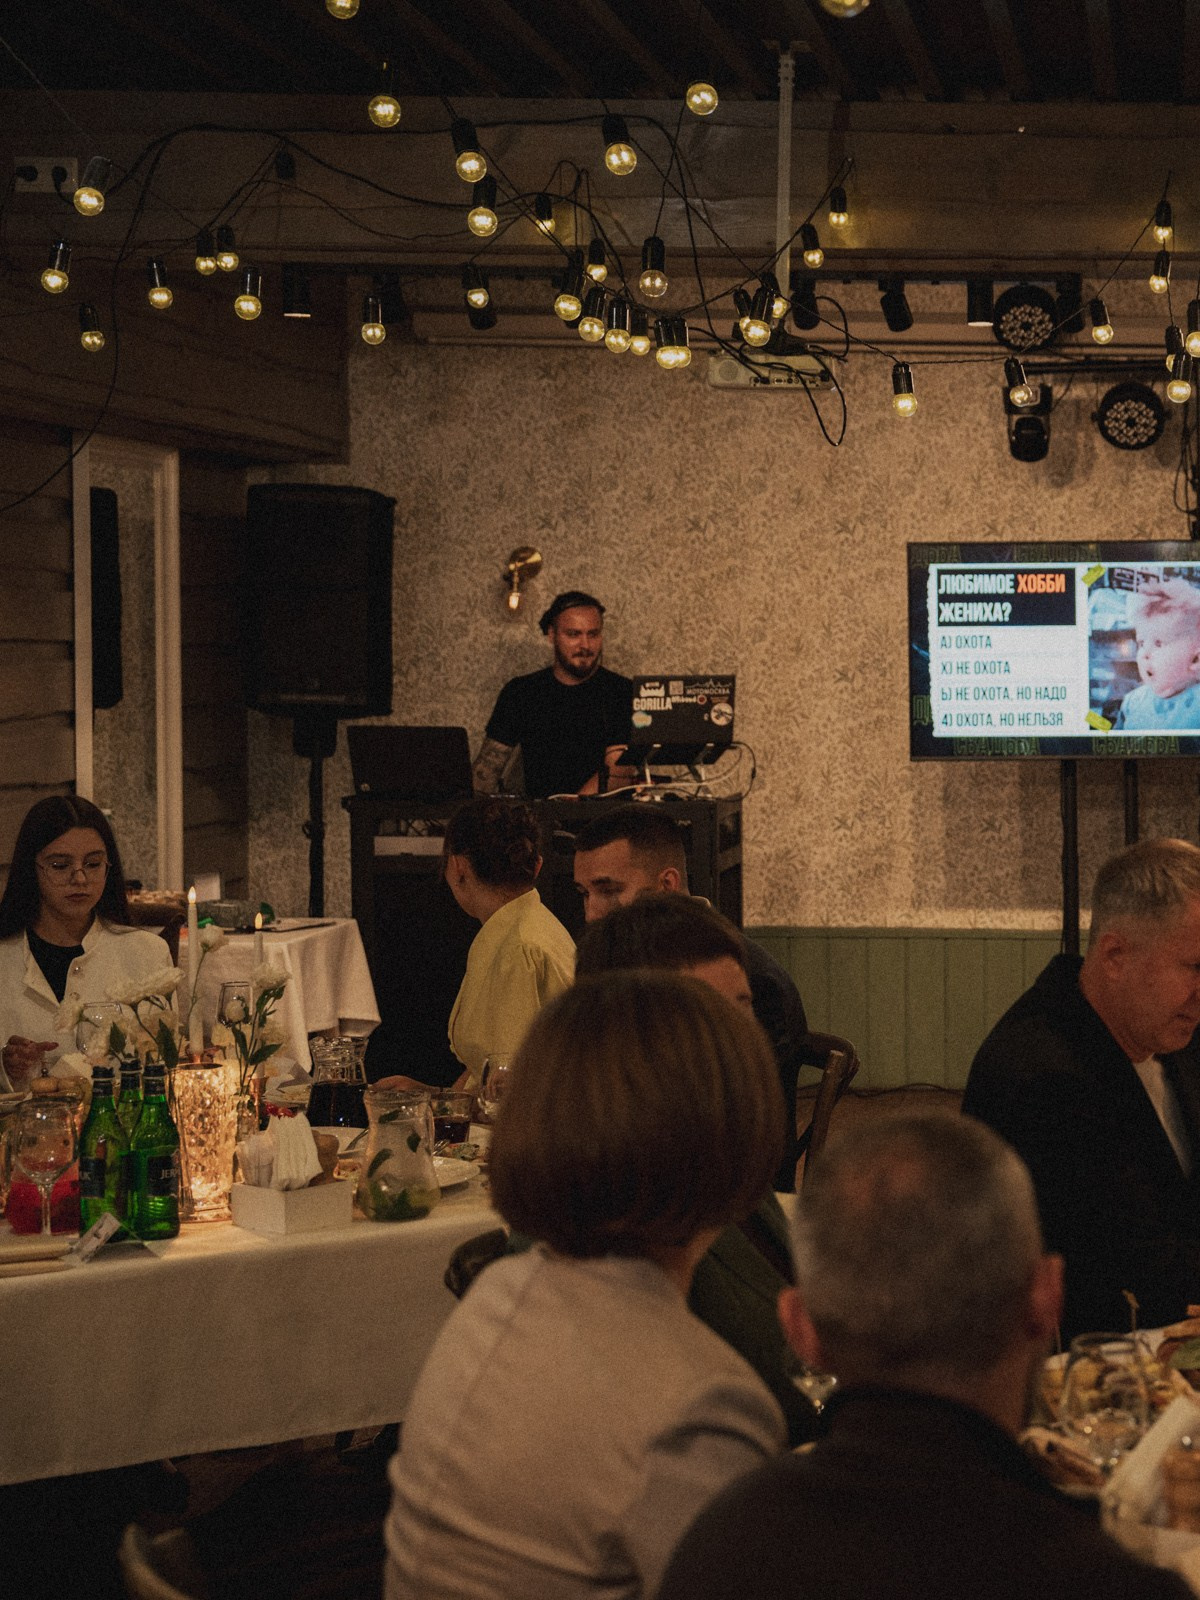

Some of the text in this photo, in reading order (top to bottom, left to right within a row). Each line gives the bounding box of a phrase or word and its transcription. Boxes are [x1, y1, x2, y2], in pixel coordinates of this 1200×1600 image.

[938, 573, 1066, 594] ЛЮБИМОЕ ХОББИ
[939, 602, 1012, 622] ЖЕНИХА?
[940, 635, 992, 649] А) ОХОТА
[941, 660, 1011, 675] Х) НЕ ОХОТА
[955, 687, 969, 701] НЕ
[973, 686, 1013, 702] ОХОТА,
[1017, 686, 1032, 700] НО
[1035, 686, 1067, 701] НАДО
[633, 697, 673, 711] GORILLA
[941, 712, 1063, 728] 4) ОХОТА, НО НЕЛЬЗЯ
